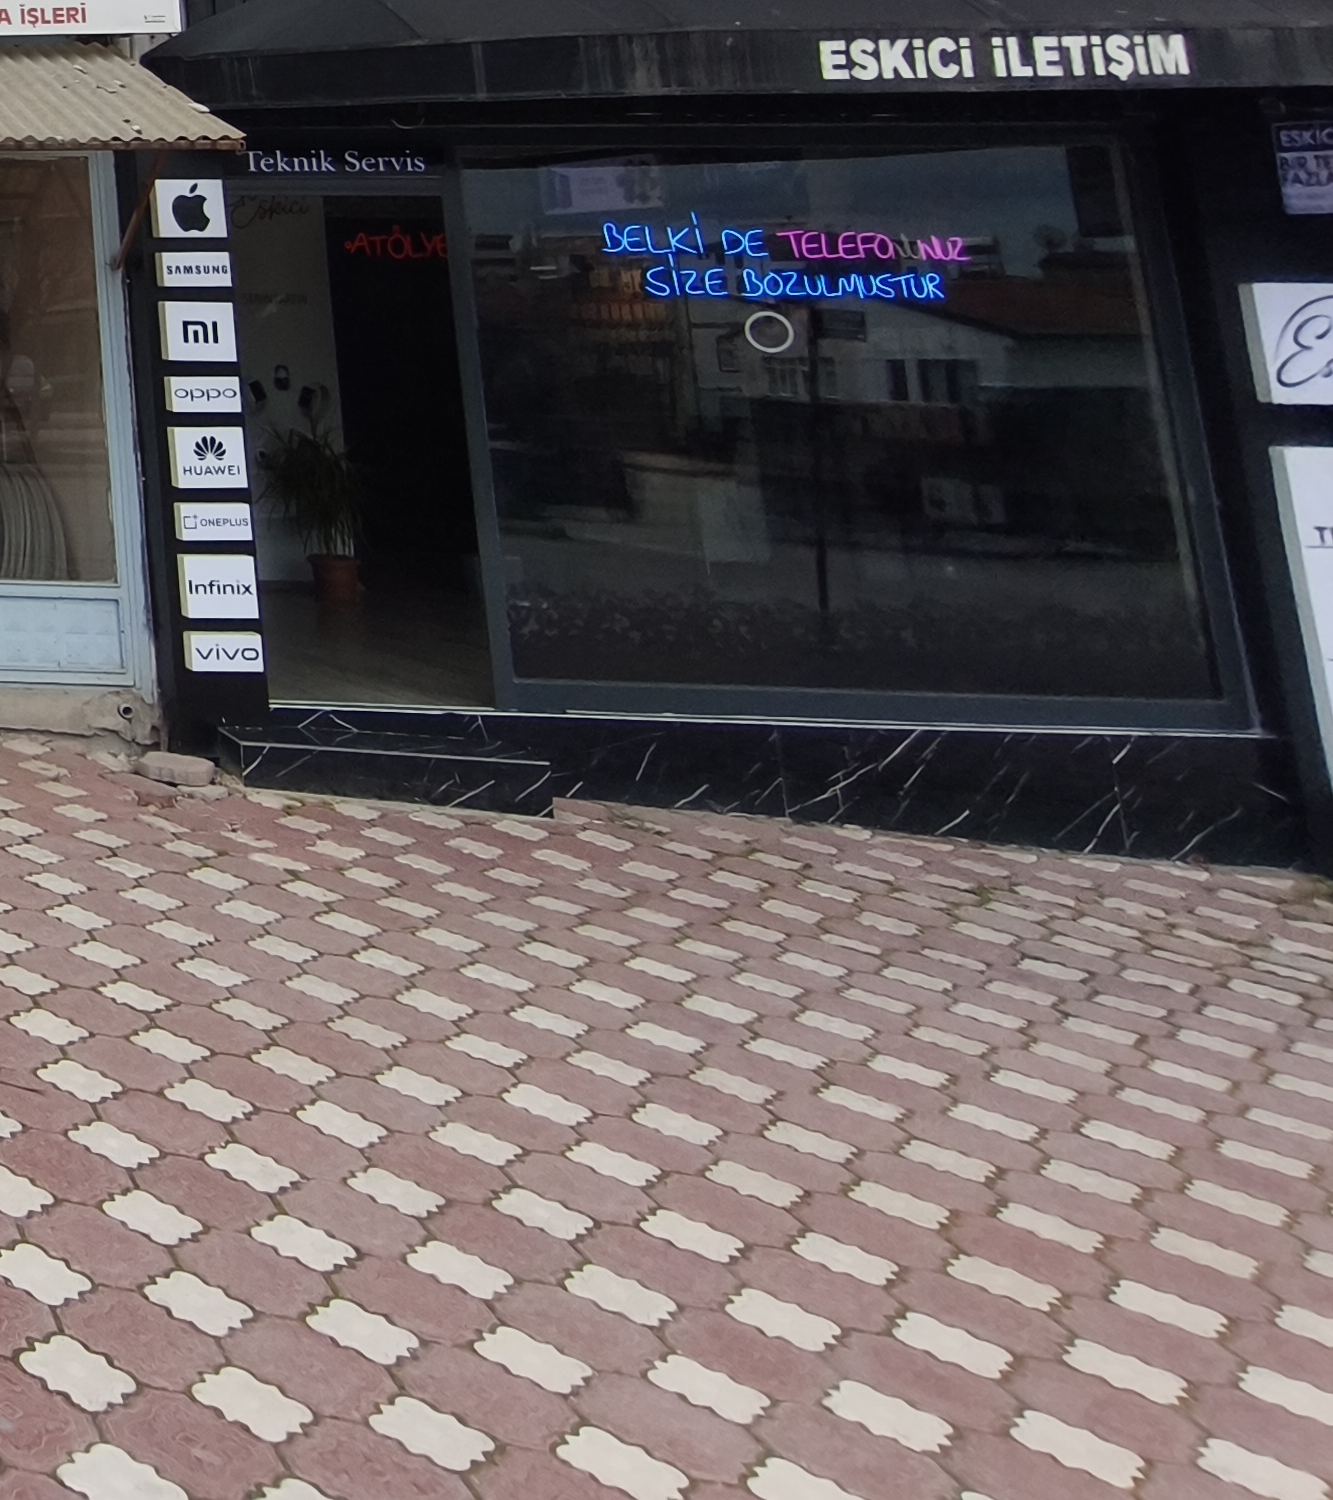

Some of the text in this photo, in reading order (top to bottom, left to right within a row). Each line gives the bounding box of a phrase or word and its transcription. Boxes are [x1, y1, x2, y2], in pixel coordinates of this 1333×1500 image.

[21, 3, 88, 28] İŞLERİ
[247, 150, 426, 173] Teknik Servis
[721, 228, 769, 257] DE
[166, 265, 228, 275] SAMSUNG
[183, 464, 241, 476] HUAWEI
[200, 517, 249, 527] ONEPLUS
[188, 579, 254, 596] Infinix
[195, 643, 260, 661] vivo
